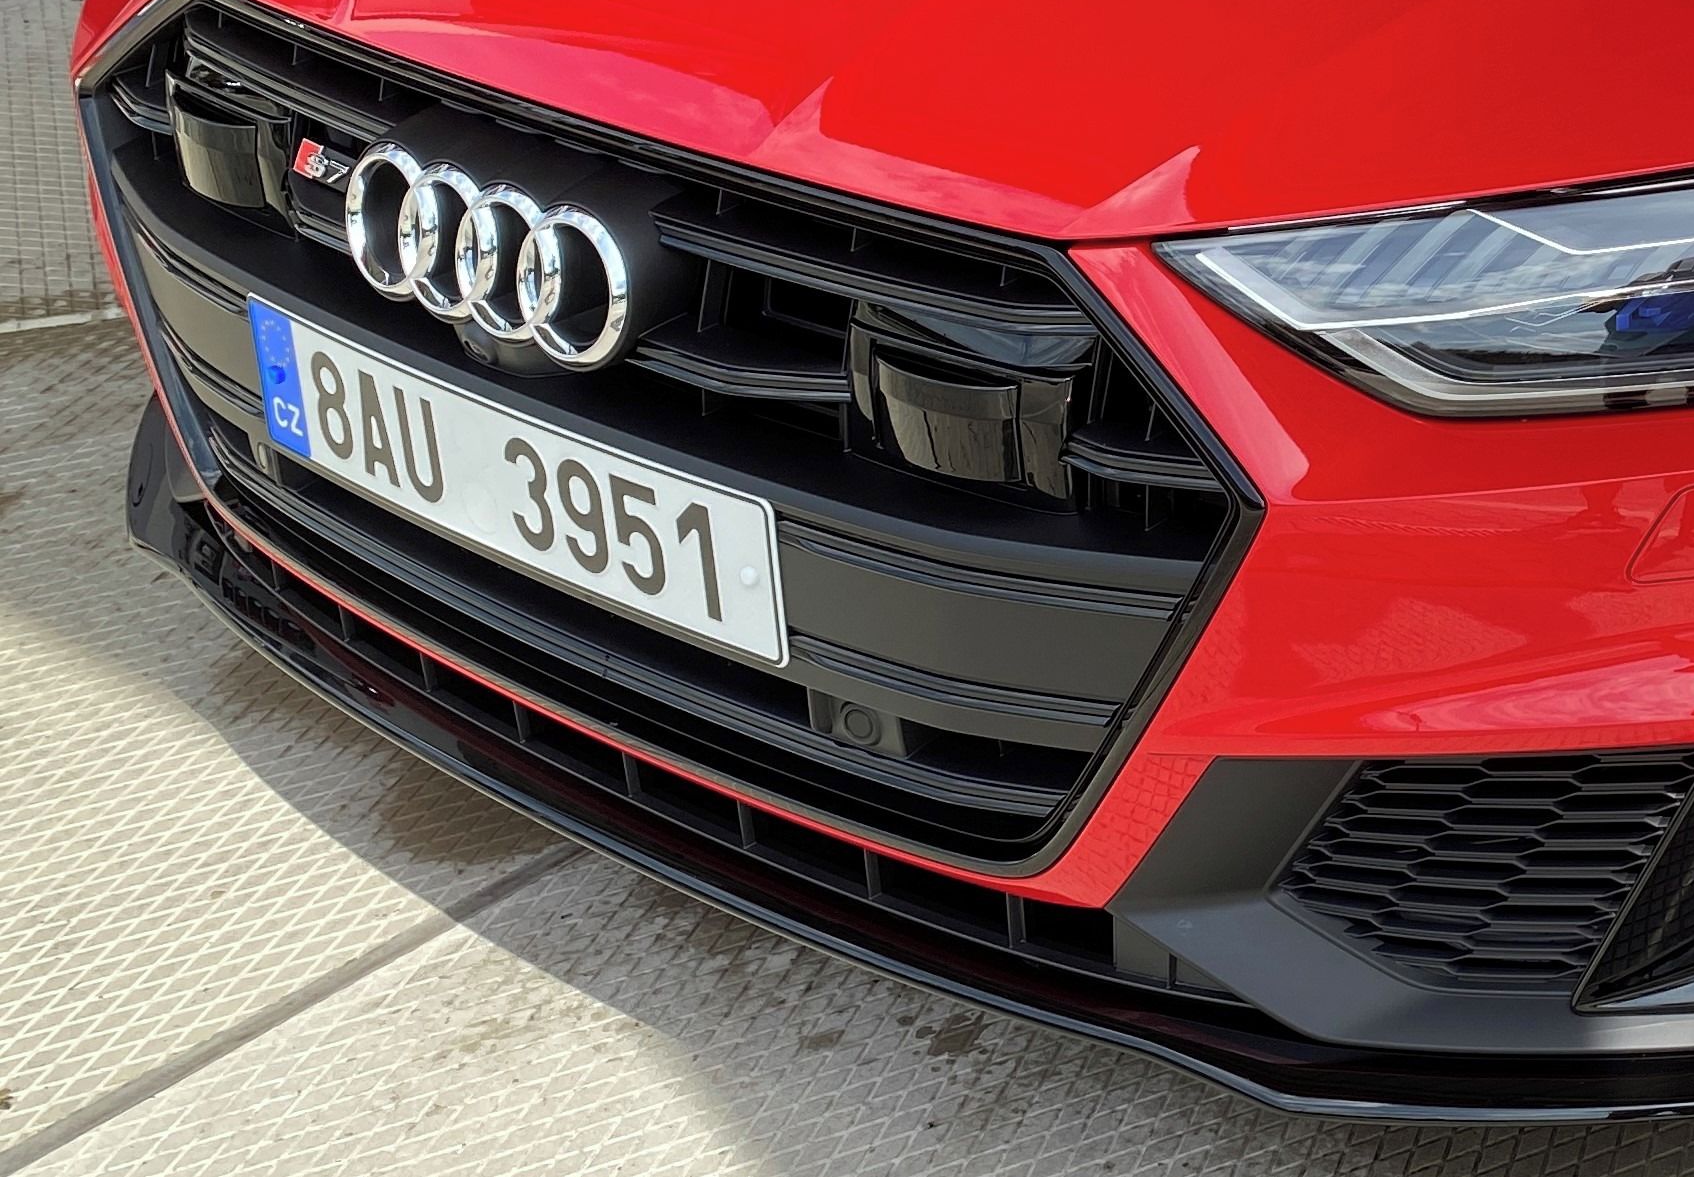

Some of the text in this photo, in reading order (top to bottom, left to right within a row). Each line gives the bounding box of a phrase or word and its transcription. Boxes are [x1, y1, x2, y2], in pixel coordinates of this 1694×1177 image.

[273, 396, 303, 437] CZ
[310, 350, 723, 622] 8AU 3951
